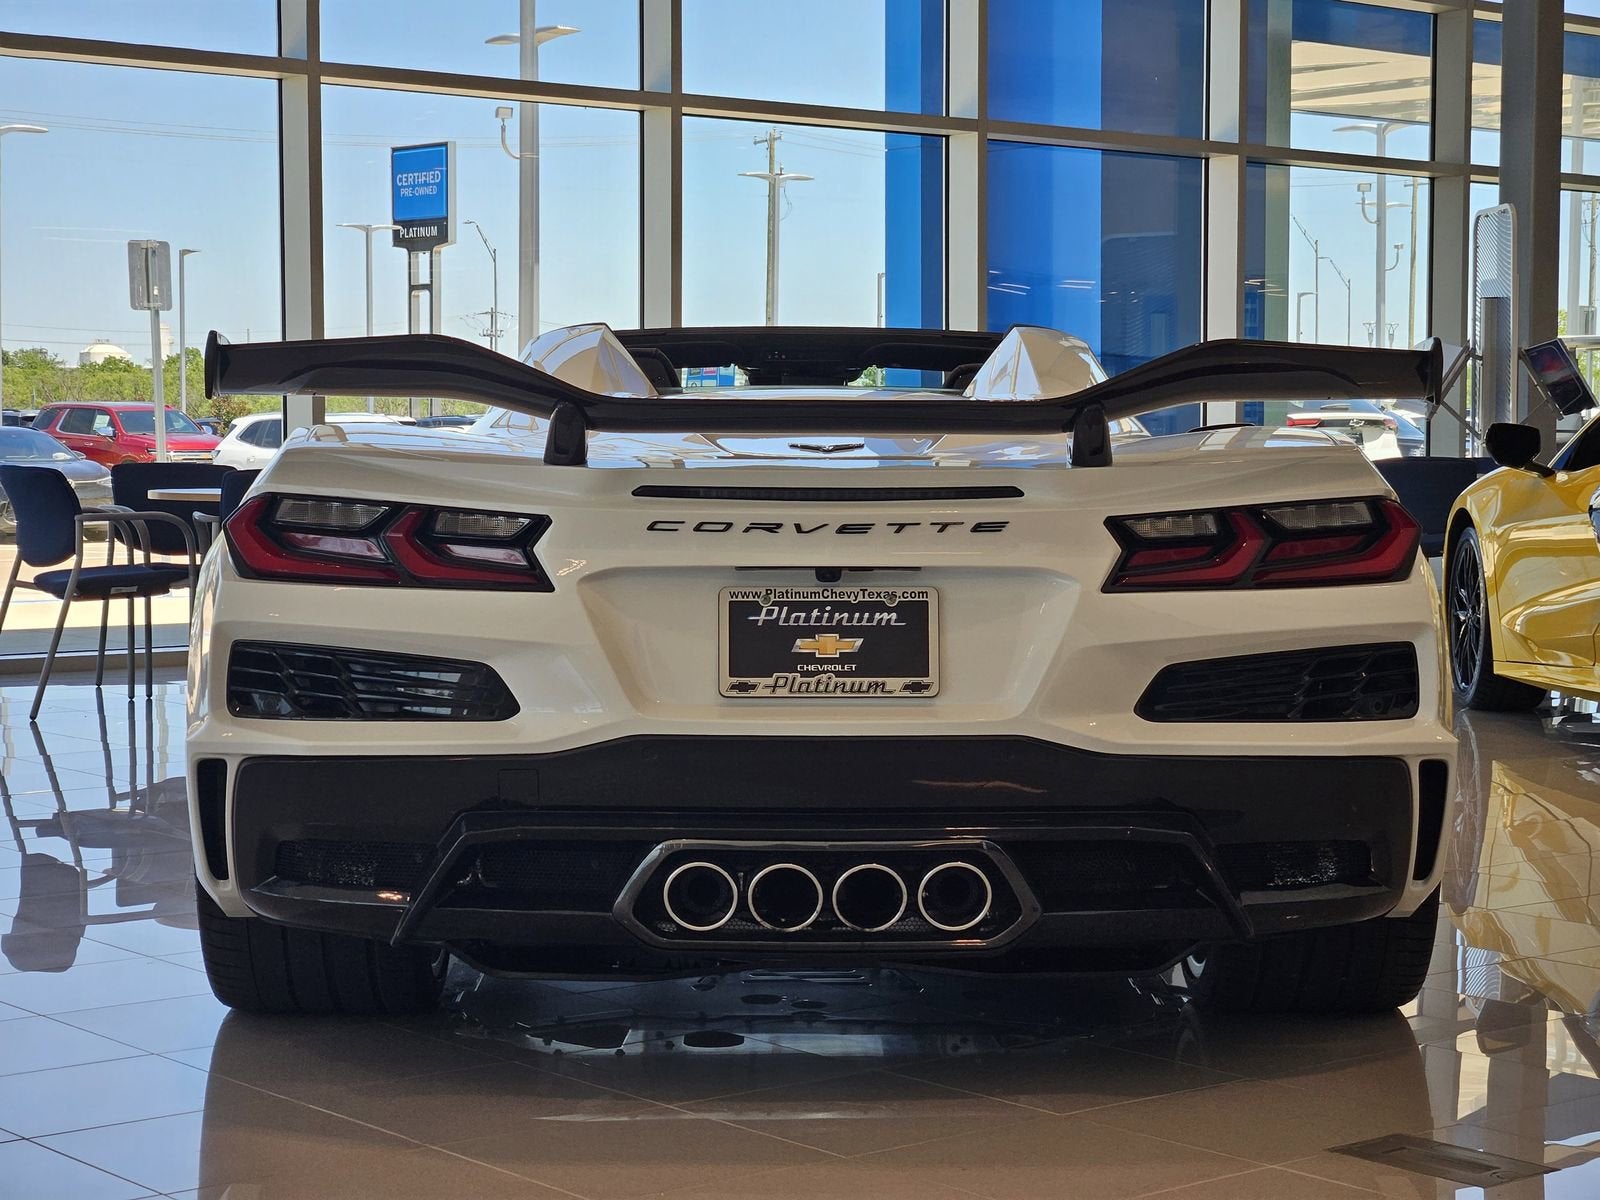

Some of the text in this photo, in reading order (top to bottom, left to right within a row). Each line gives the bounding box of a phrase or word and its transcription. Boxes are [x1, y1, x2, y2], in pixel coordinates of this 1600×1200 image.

[397, 171, 441, 186] CERTIFIED
[400, 186, 437, 197] PRE-OWNED
[400, 226, 437, 238] PLATINUM
[646, 520, 1010, 534] CORVETTE
[729, 588, 929, 601] wwwPlatinumChevyTexas.com
[747, 605, 907, 626] Platinum
[797, 664, 857, 672] CHEVROLET
[762, 675, 897, 695] Platinum
